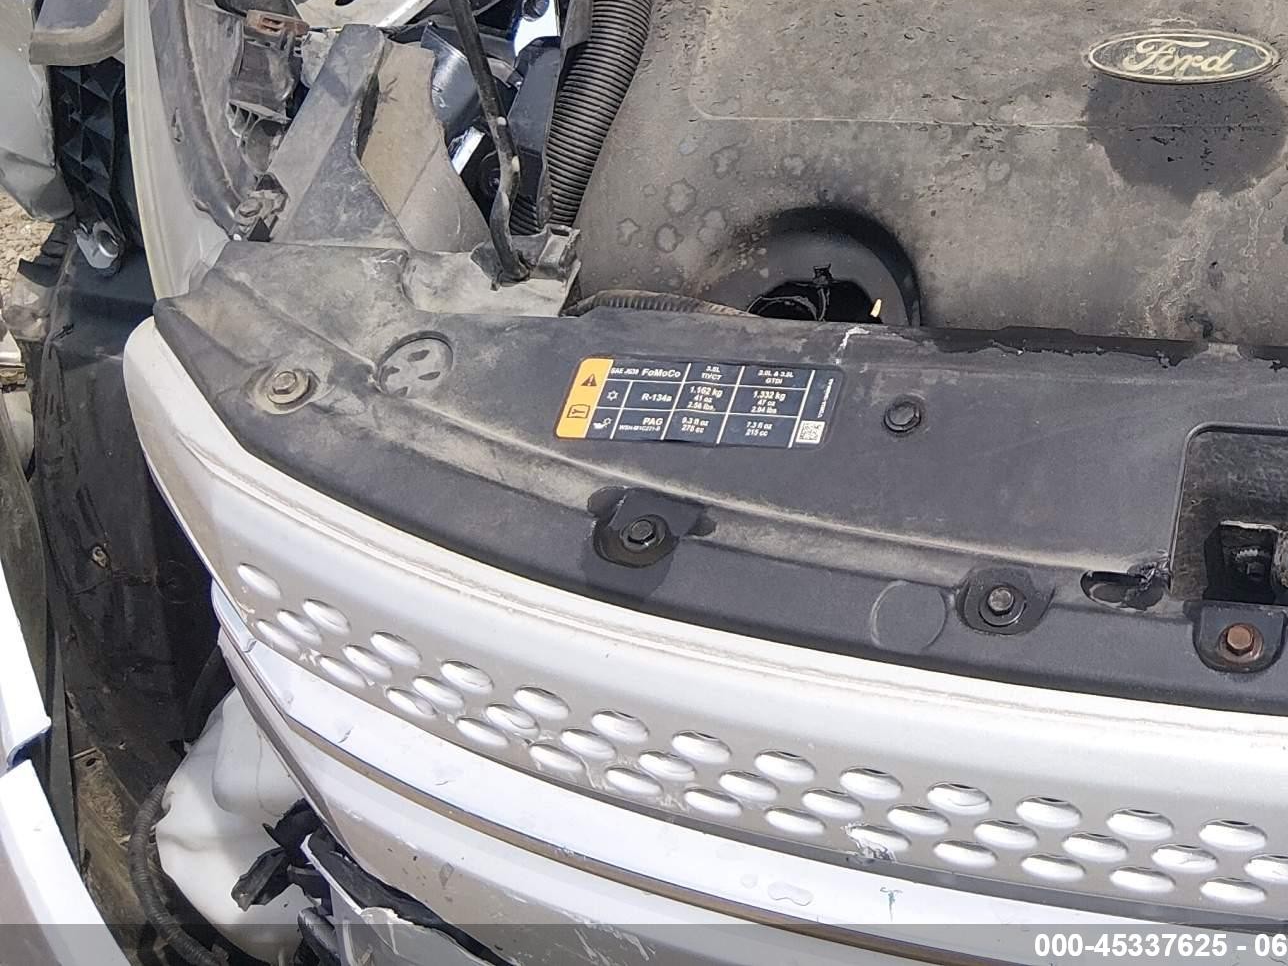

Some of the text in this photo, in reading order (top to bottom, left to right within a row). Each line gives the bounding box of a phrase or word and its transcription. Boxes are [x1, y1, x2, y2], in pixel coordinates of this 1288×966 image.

[1121, 38, 1238, 73] Ford
[641, 368, 682, 378] FoMoCo
[641, 392, 673, 402] R-134a
[690, 386, 723, 398] 1.162 kg
[753, 390, 786, 401] 1.332 kg
[642, 417, 664, 426] PAG
